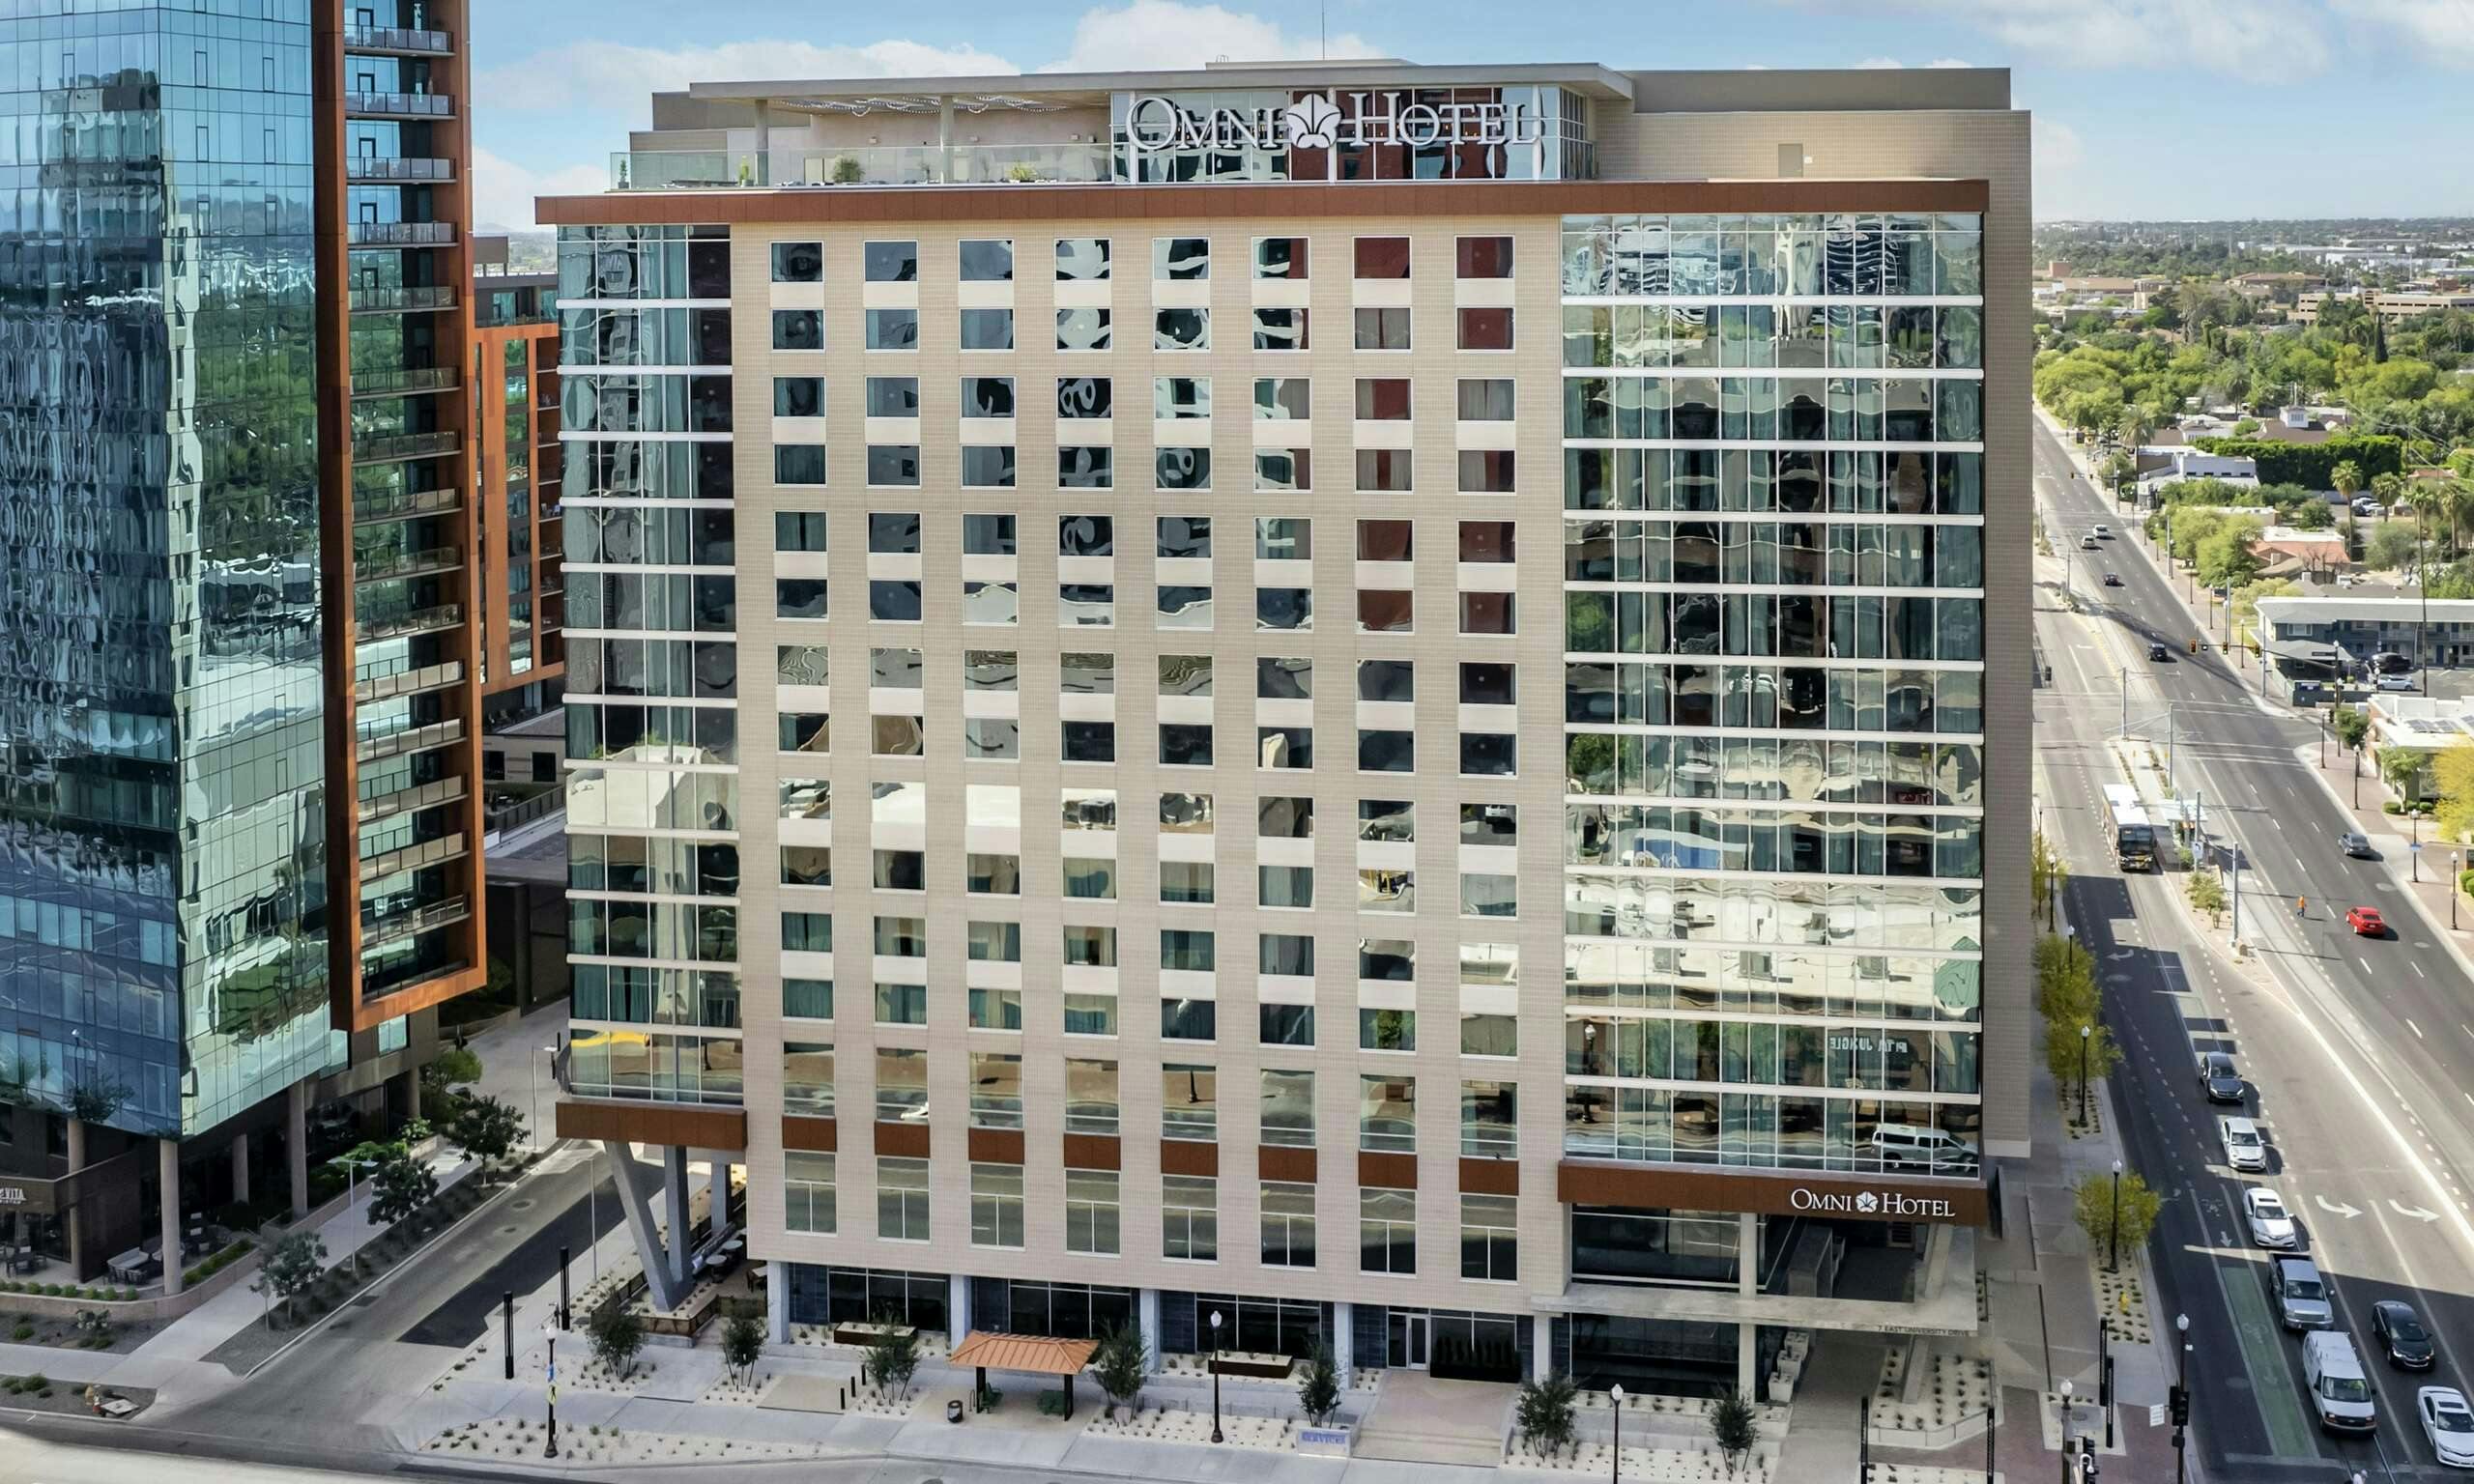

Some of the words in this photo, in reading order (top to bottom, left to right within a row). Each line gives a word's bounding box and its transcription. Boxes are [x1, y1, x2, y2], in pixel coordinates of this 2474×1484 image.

[1126, 96, 1285, 152] OMNI
[1348, 91, 1541, 147] HOTEL
[1791, 1188, 1852, 1213] OMNI
[1882, 1191, 1956, 1218] HOTEL
